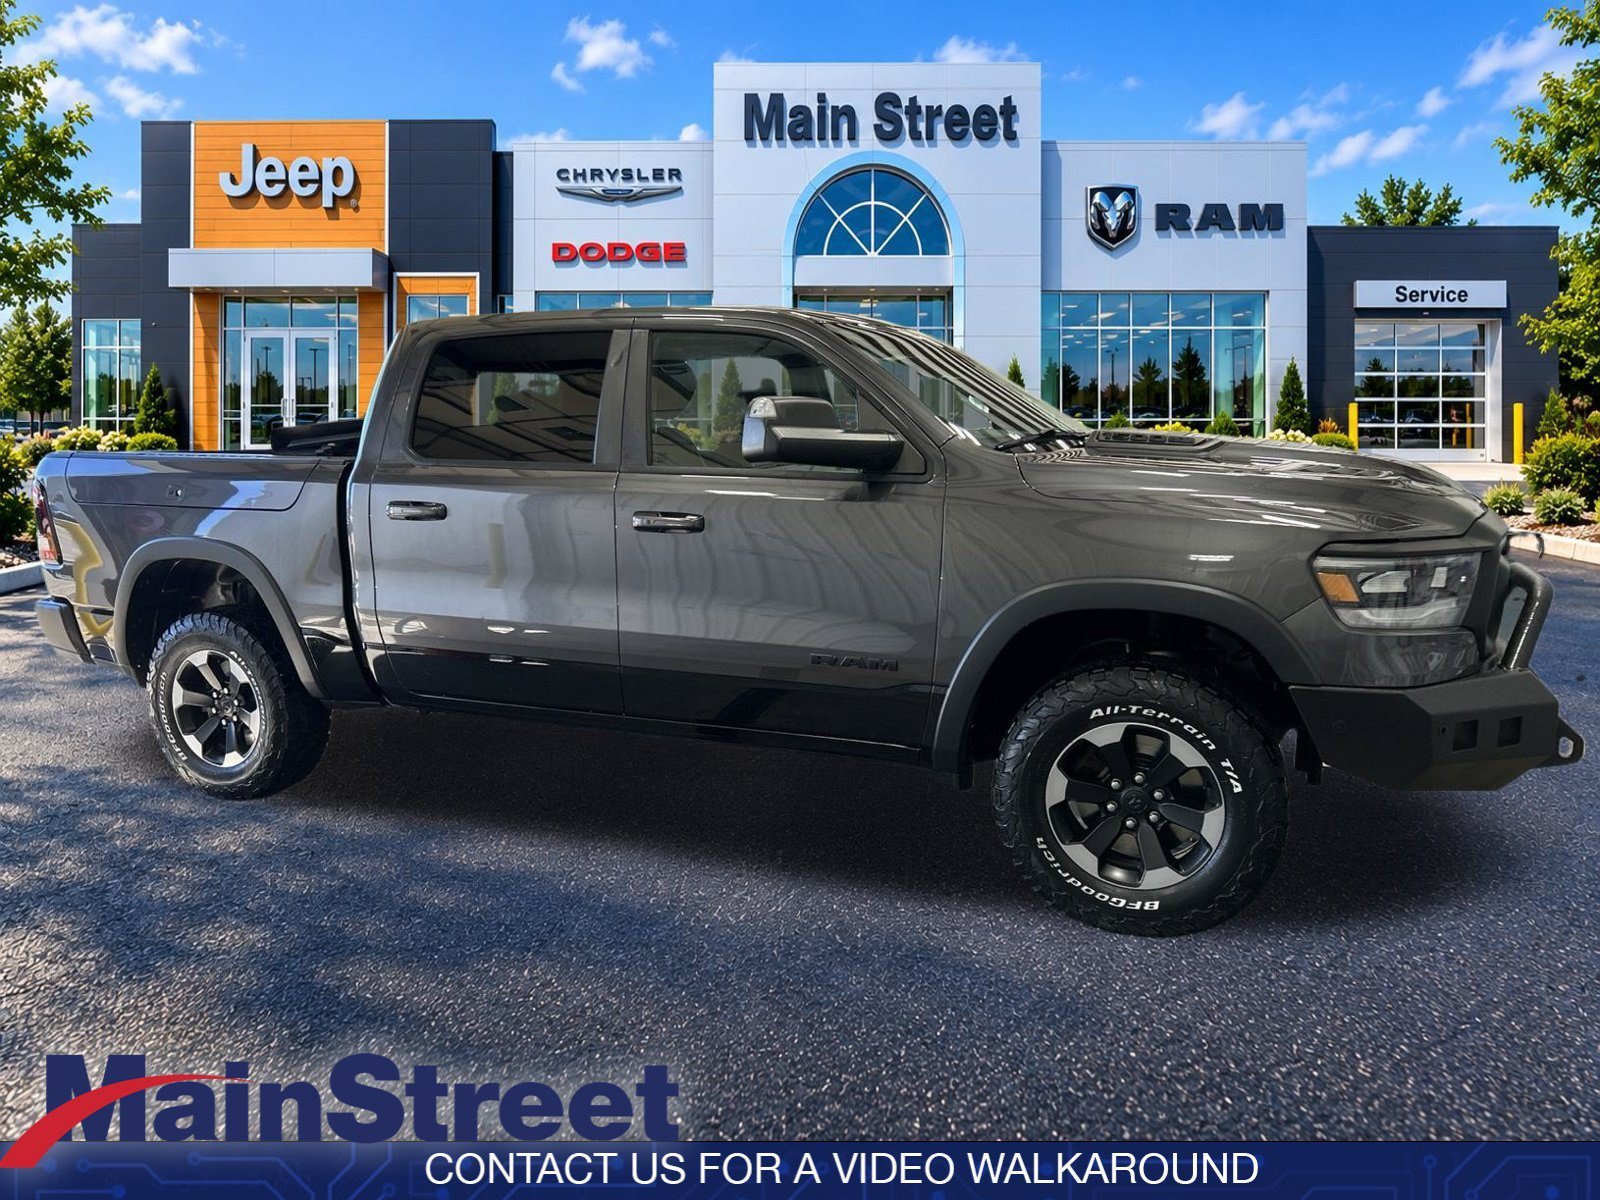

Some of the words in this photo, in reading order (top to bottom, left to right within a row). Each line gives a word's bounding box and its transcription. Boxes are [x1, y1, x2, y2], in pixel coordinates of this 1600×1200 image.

[744, 93, 857, 141] Main
[873, 91, 1018, 142] Street
[219, 143, 356, 209] Jeep
[556, 168, 683, 182] CHRYSLER
[1155, 203, 1285, 232] RAM
[551, 242, 687, 263] DODGE
[1395, 285, 1469, 303] Service
[810, 653, 899, 672] RAM
[1089, 704, 1217, 751] All-Terrain
[1219, 757, 1244, 794] T/A
[1035, 836, 1161, 911] BFGoodrich
